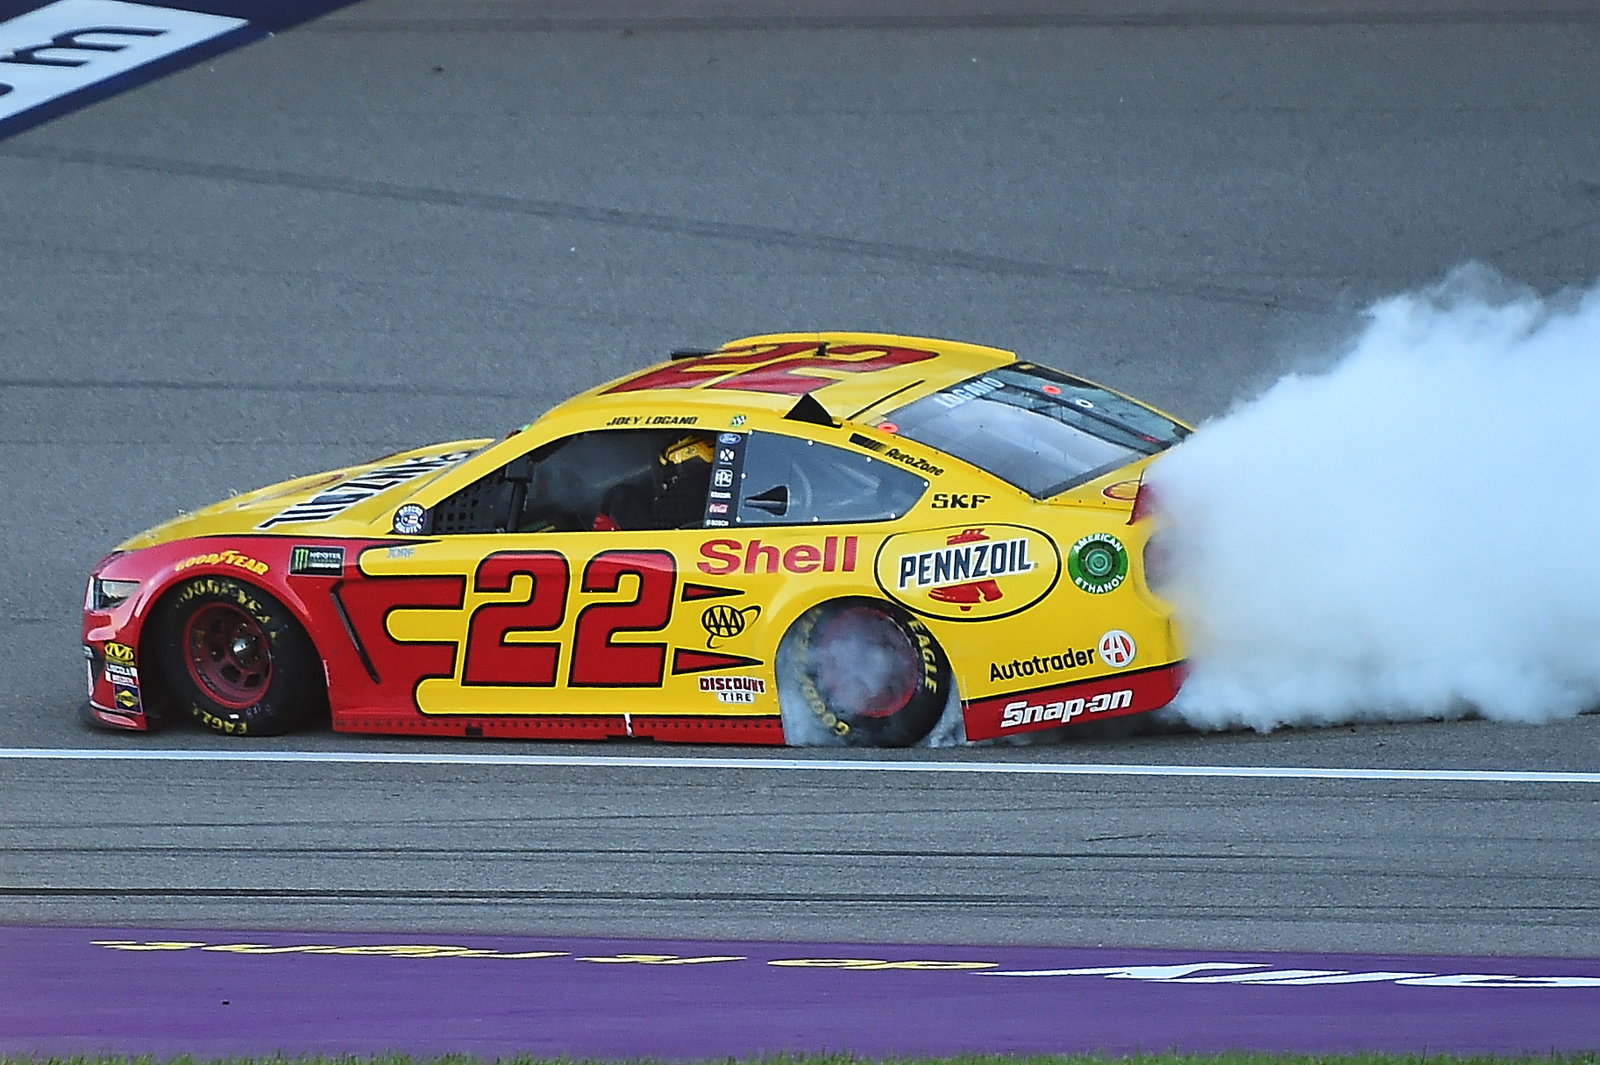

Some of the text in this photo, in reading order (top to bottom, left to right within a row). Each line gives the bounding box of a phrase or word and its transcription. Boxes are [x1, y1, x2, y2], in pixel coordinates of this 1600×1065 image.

[598, 342, 940, 395] 22
[606, 415, 698, 426] JOEY LOGANO
[885, 448, 945, 477] AutoZone
[931, 494, 991, 509] SKF
[696, 536, 858, 575] Shell
[1072, 532, 1124, 553] AMERICAN
[175, 550, 269, 576] GOODYEAR
[898, 537, 1034, 590] PENNZOIL
[1073, 573, 1124, 593] ETHANOL
[461, 549, 677, 688] 22
[707, 605, 740, 637] AAA
[908, 618, 939, 694] EAGLE
[989, 647, 1095, 683] Autotrader
[699, 676, 765, 693] DISCOUNT
[720, 691, 752, 702] TIRE
[1000, 689, 1133, 728] Snap-on
